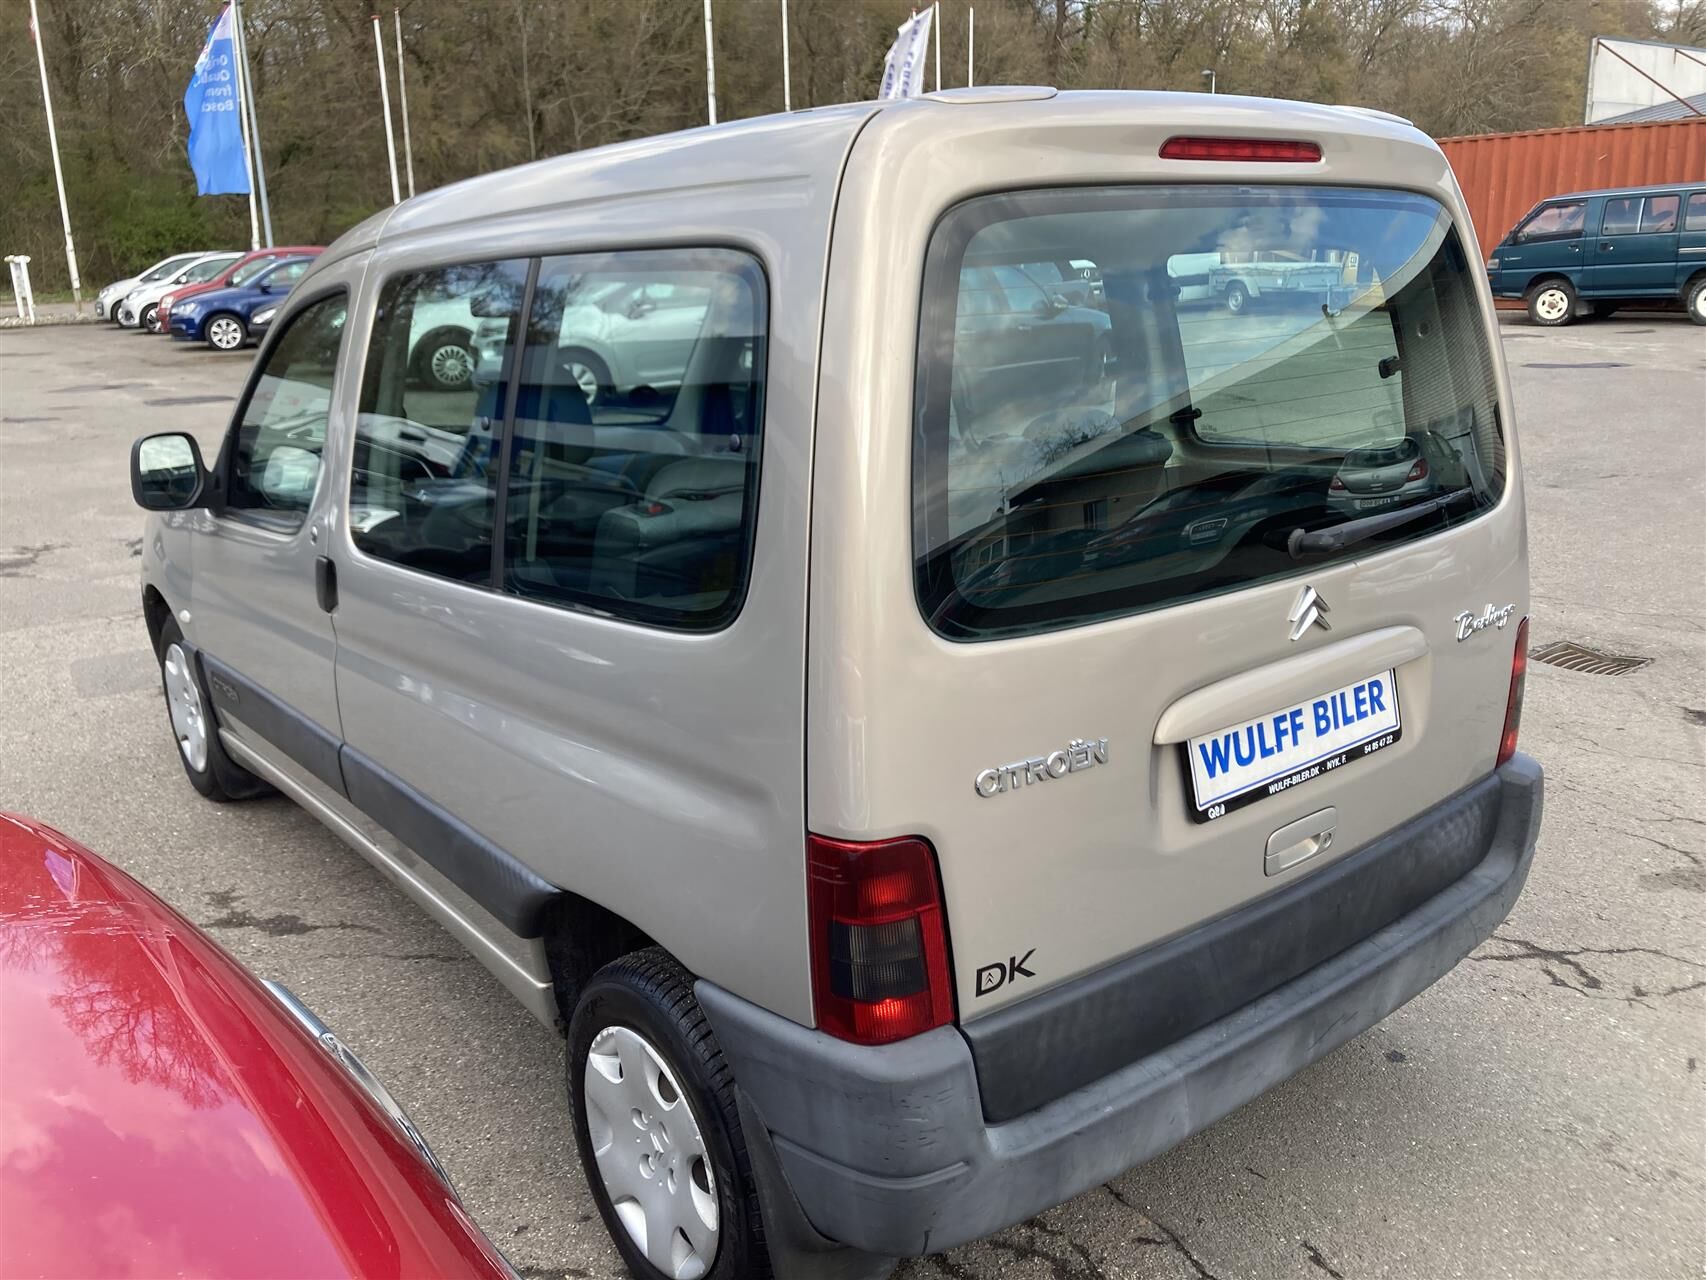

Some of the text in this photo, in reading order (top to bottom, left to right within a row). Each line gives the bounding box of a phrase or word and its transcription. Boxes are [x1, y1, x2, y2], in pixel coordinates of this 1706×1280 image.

[1454, 603, 1515, 642] Berlingo
[1198, 679, 1386, 779] WULFF BILER
[975, 737, 1109, 798] CITROËN
[1268, 766, 1320, 794] WULFF-BILER.DK
[975, 948, 1037, 998] DK
